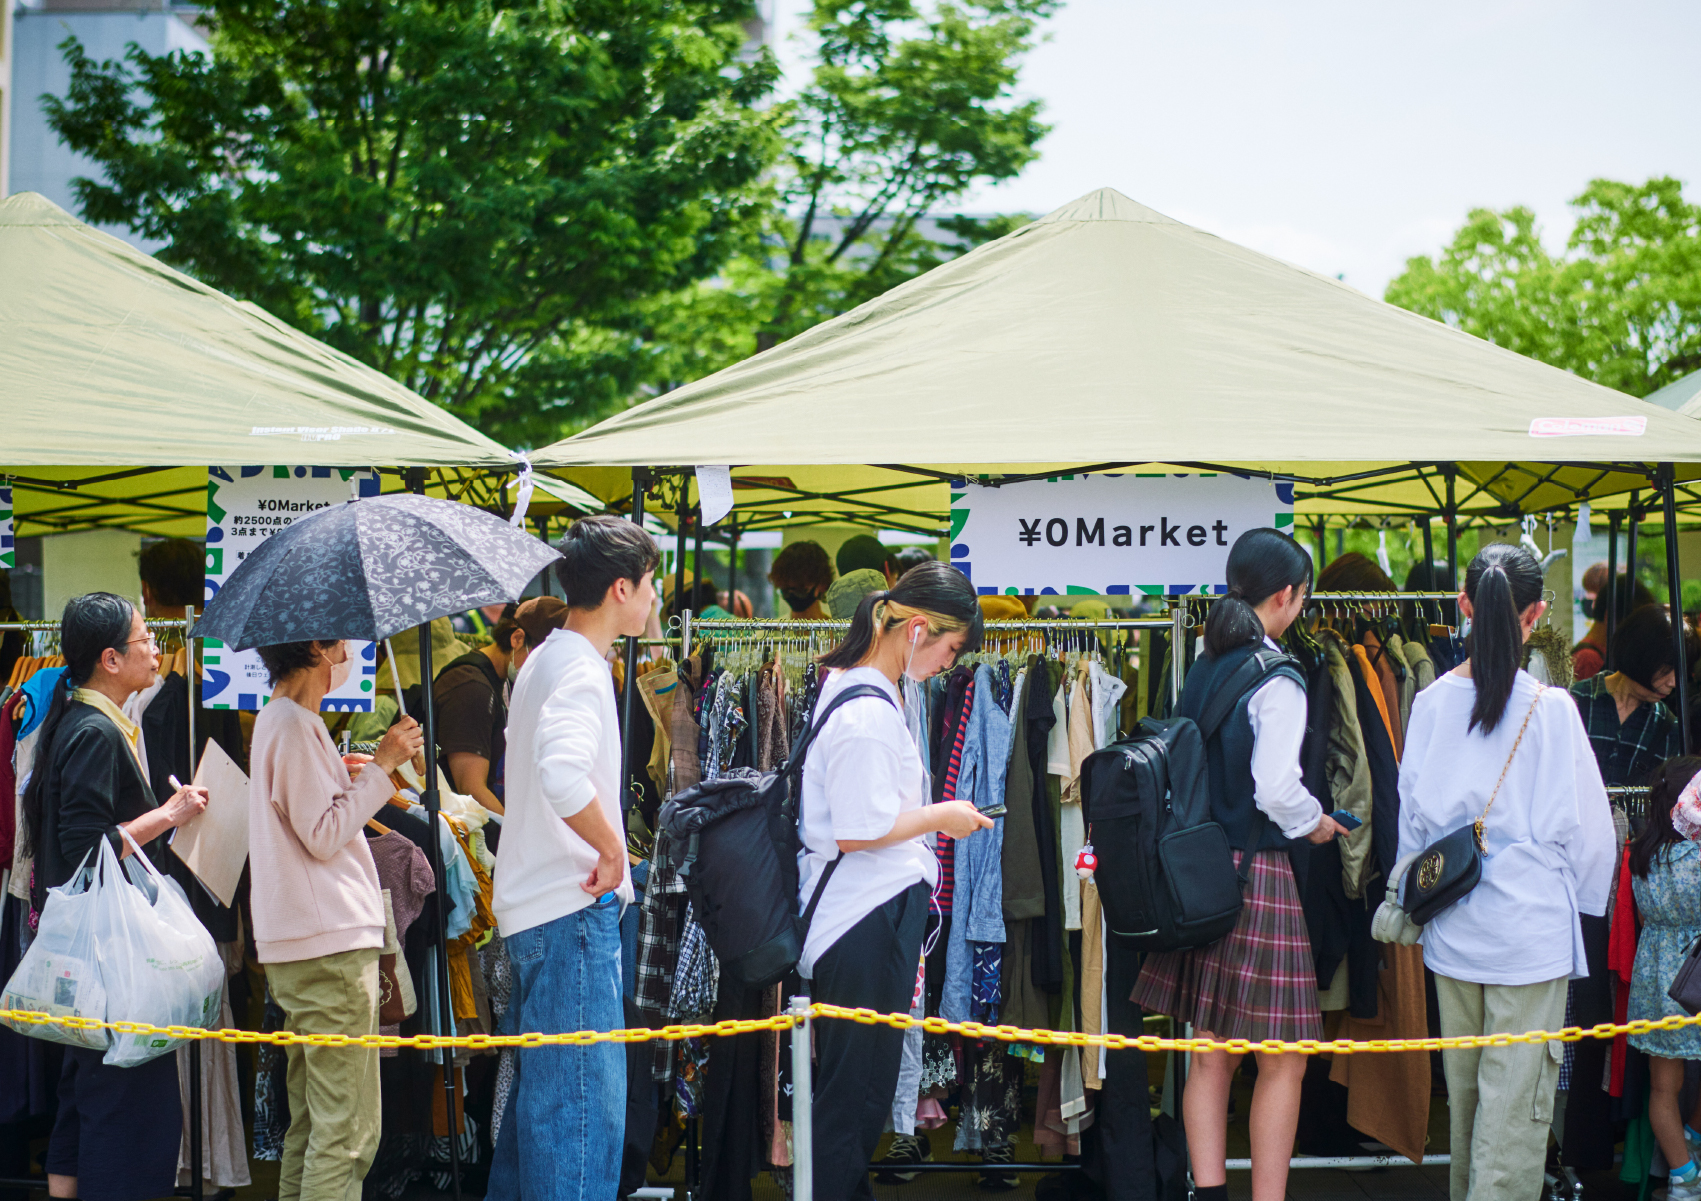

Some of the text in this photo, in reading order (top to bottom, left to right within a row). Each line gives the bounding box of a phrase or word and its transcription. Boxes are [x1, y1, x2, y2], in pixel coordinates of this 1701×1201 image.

[251, 426, 296, 434] Instant
[233, 515, 300, 526] 約2500点の
[1018, 516, 1228, 547] ¥0Market
